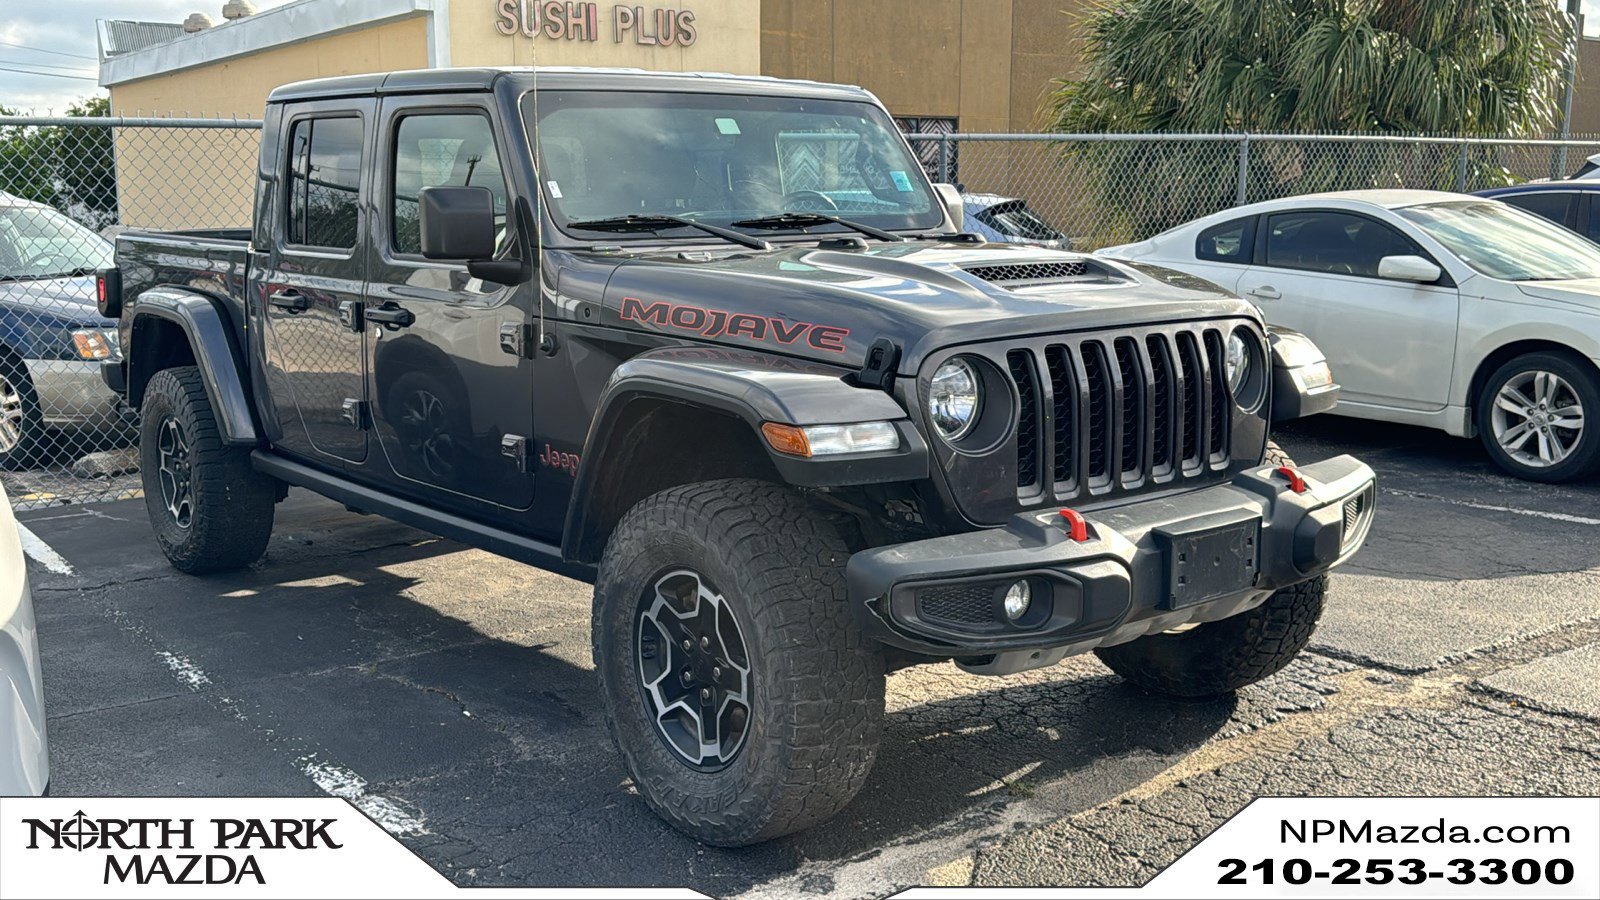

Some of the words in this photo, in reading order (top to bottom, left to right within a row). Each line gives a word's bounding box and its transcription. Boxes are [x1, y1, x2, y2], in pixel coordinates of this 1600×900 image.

[495, 0, 598, 41] SUSHI
[613, 5, 698, 46] PLUS
[620, 297, 849, 352] MOJAVE
[540, 443, 580, 477] Jeep
